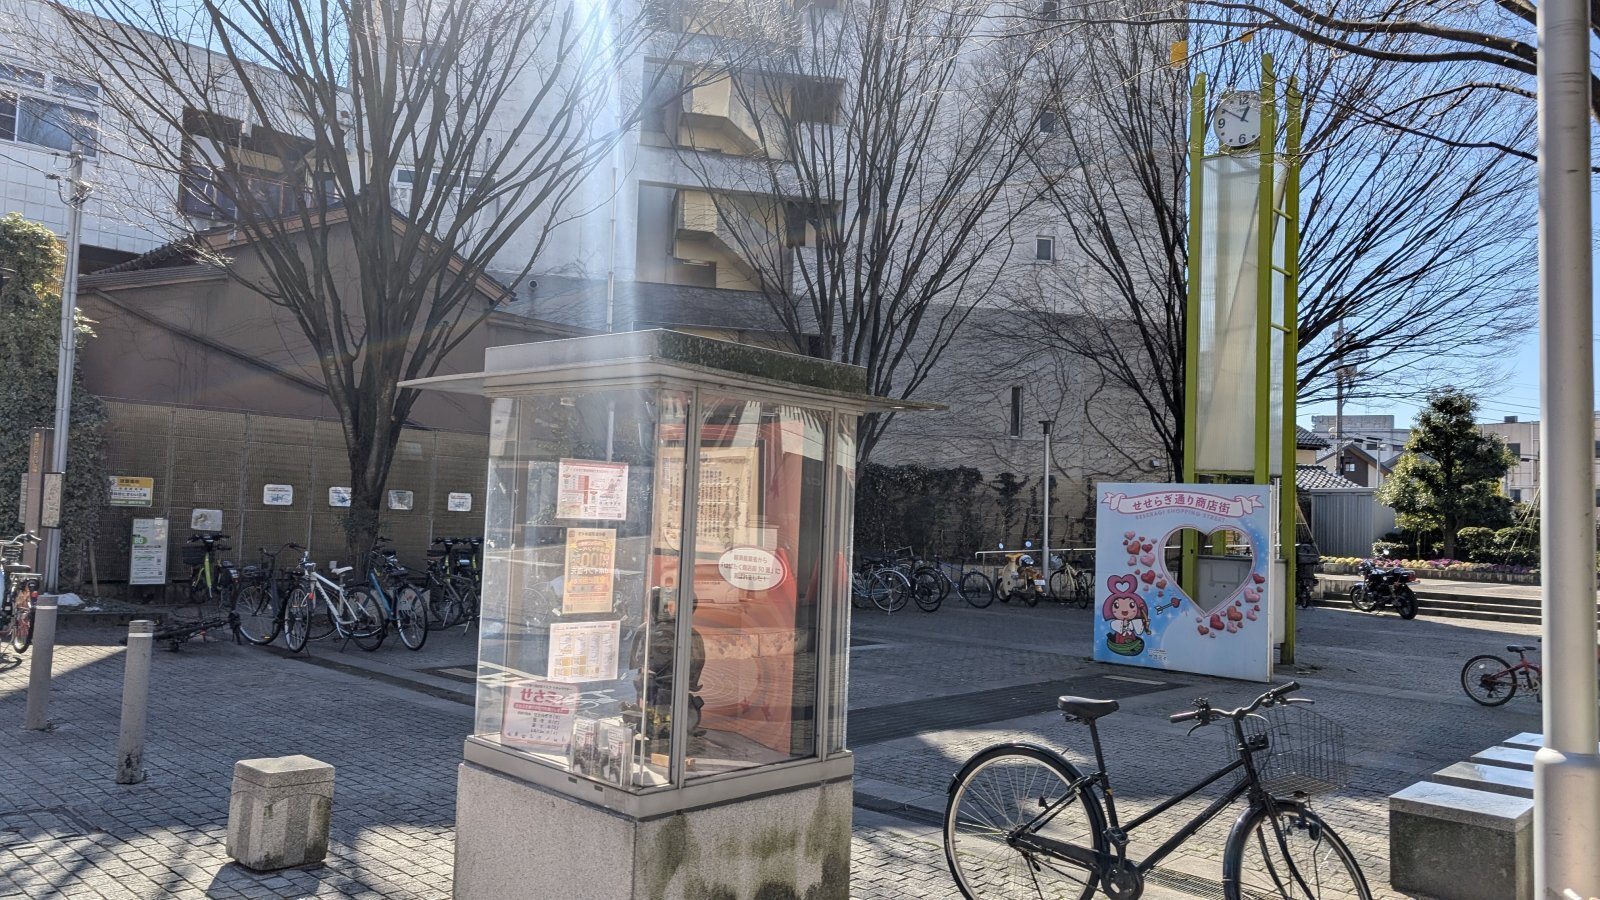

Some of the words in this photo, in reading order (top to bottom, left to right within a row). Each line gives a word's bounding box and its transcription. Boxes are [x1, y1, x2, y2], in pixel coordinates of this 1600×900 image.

[1218, 118, 1225, 129] 9
[1238, 133, 1245, 144] 6
[1132, 493, 1231, 514] せせらぎ通り商店街
